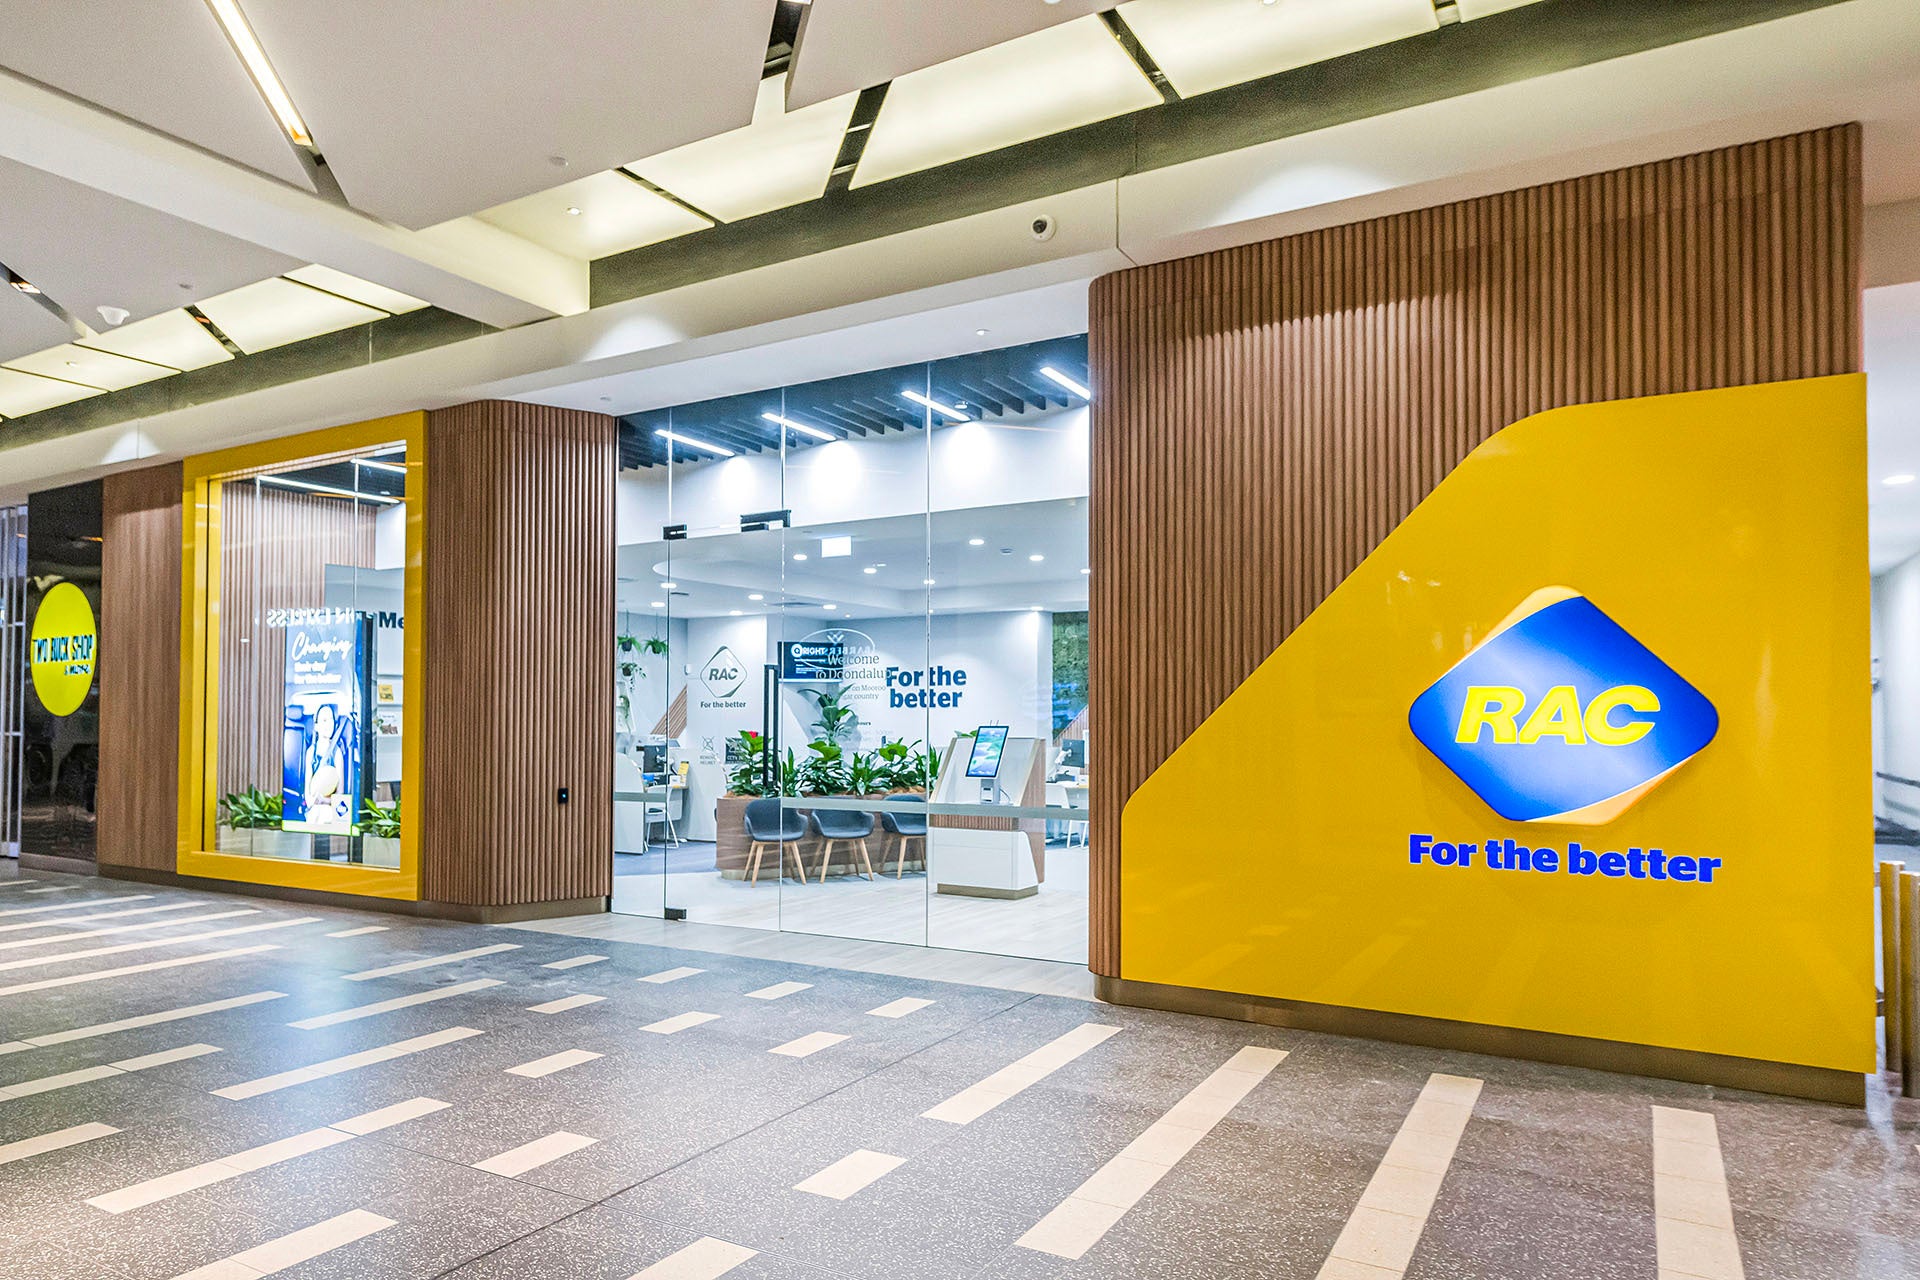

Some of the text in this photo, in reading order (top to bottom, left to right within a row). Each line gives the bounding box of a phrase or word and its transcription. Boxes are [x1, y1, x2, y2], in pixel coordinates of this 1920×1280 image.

[51, 636, 69, 662] BUCK
[73, 634, 93, 661] SHOP
[827, 653, 880, 666] Welcome
[708, 667, 739, 681] RAC
[886, 665, 967, 687] For the
[889, 688, 963, 708] better
[1454, 684, 1661, 746] RAC
[1408, 833, 1722, 883] For the better
